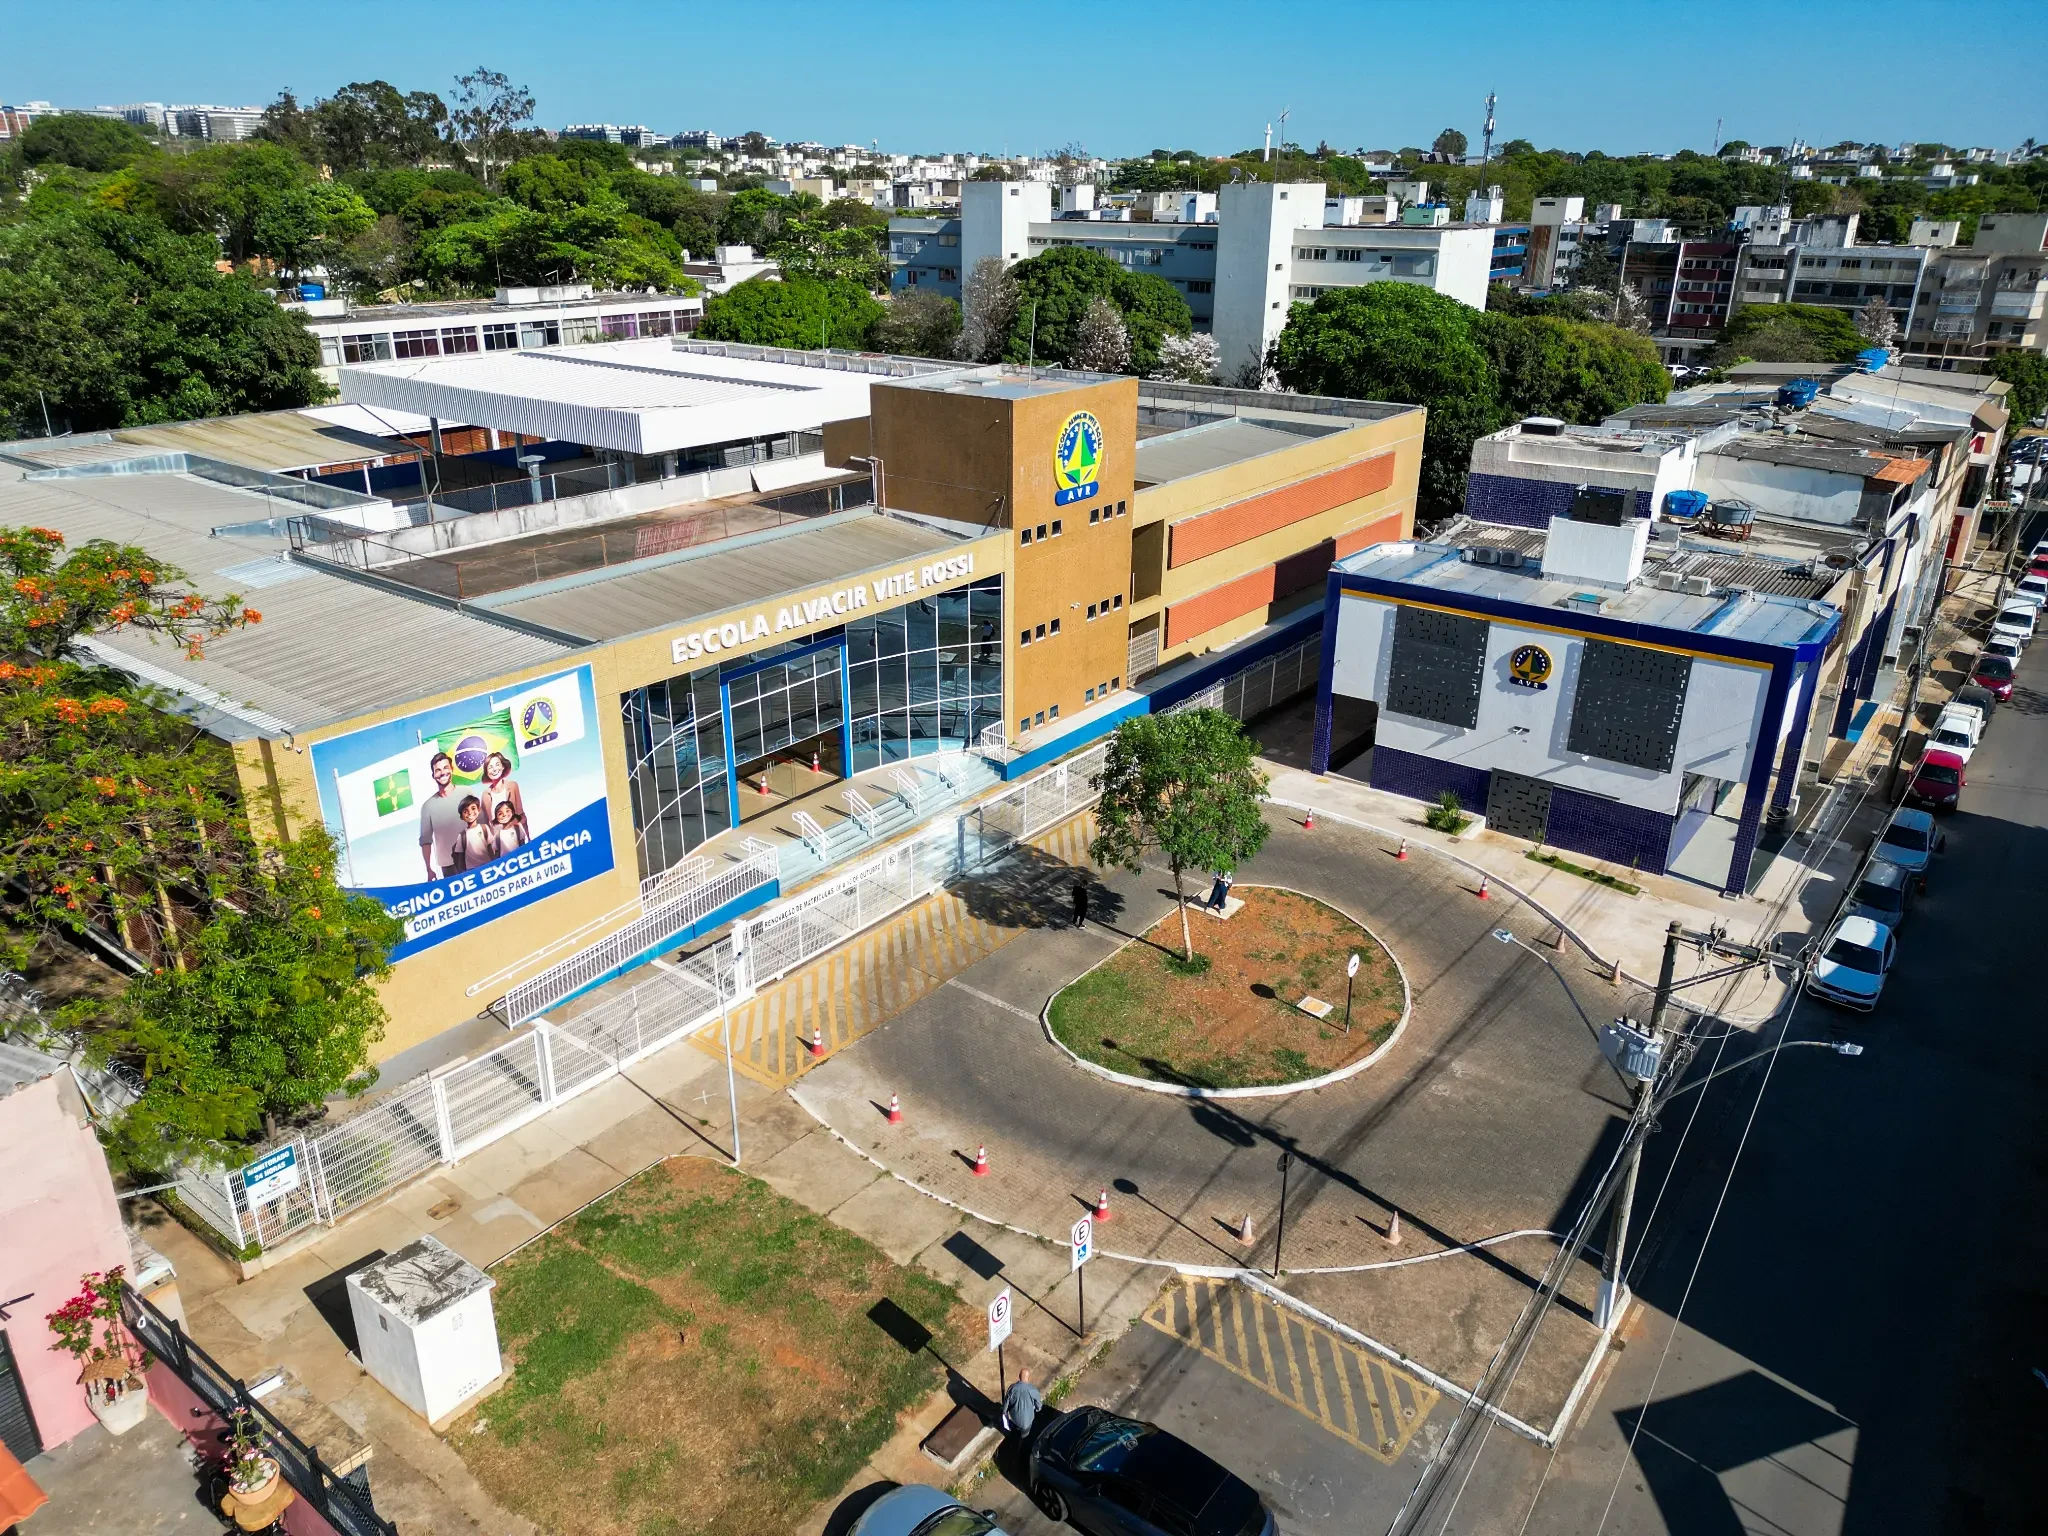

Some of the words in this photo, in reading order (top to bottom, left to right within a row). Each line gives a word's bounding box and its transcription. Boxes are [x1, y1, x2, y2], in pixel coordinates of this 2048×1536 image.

[671, 614, 770, 665] ESCOLA
[775, 585, 867, 633] ALVACIR
[872, 571, 918, 602] VITE
[921, 552, 974, 588] ROSSI
[448, 873, 477, 897] DE
[480, 829, 592, 884] EXCELÊNCIA
[413, 914, 436, 933] COM
[438, 886, 506, 922] RESULTADOS
[508, 874, 534, 893] PARA
[536, 871, 542, 881] A
[544, 861, 568, 878] VIDA.
[246, 1150, 290, 1177] MONITORADO
[254, 1172, 264, 1182] 24
[263, 1161, 286, 1178] HORAS
[1078, 1224, 1085, 1241] E
[996, 1302, 1003, 1318] E
